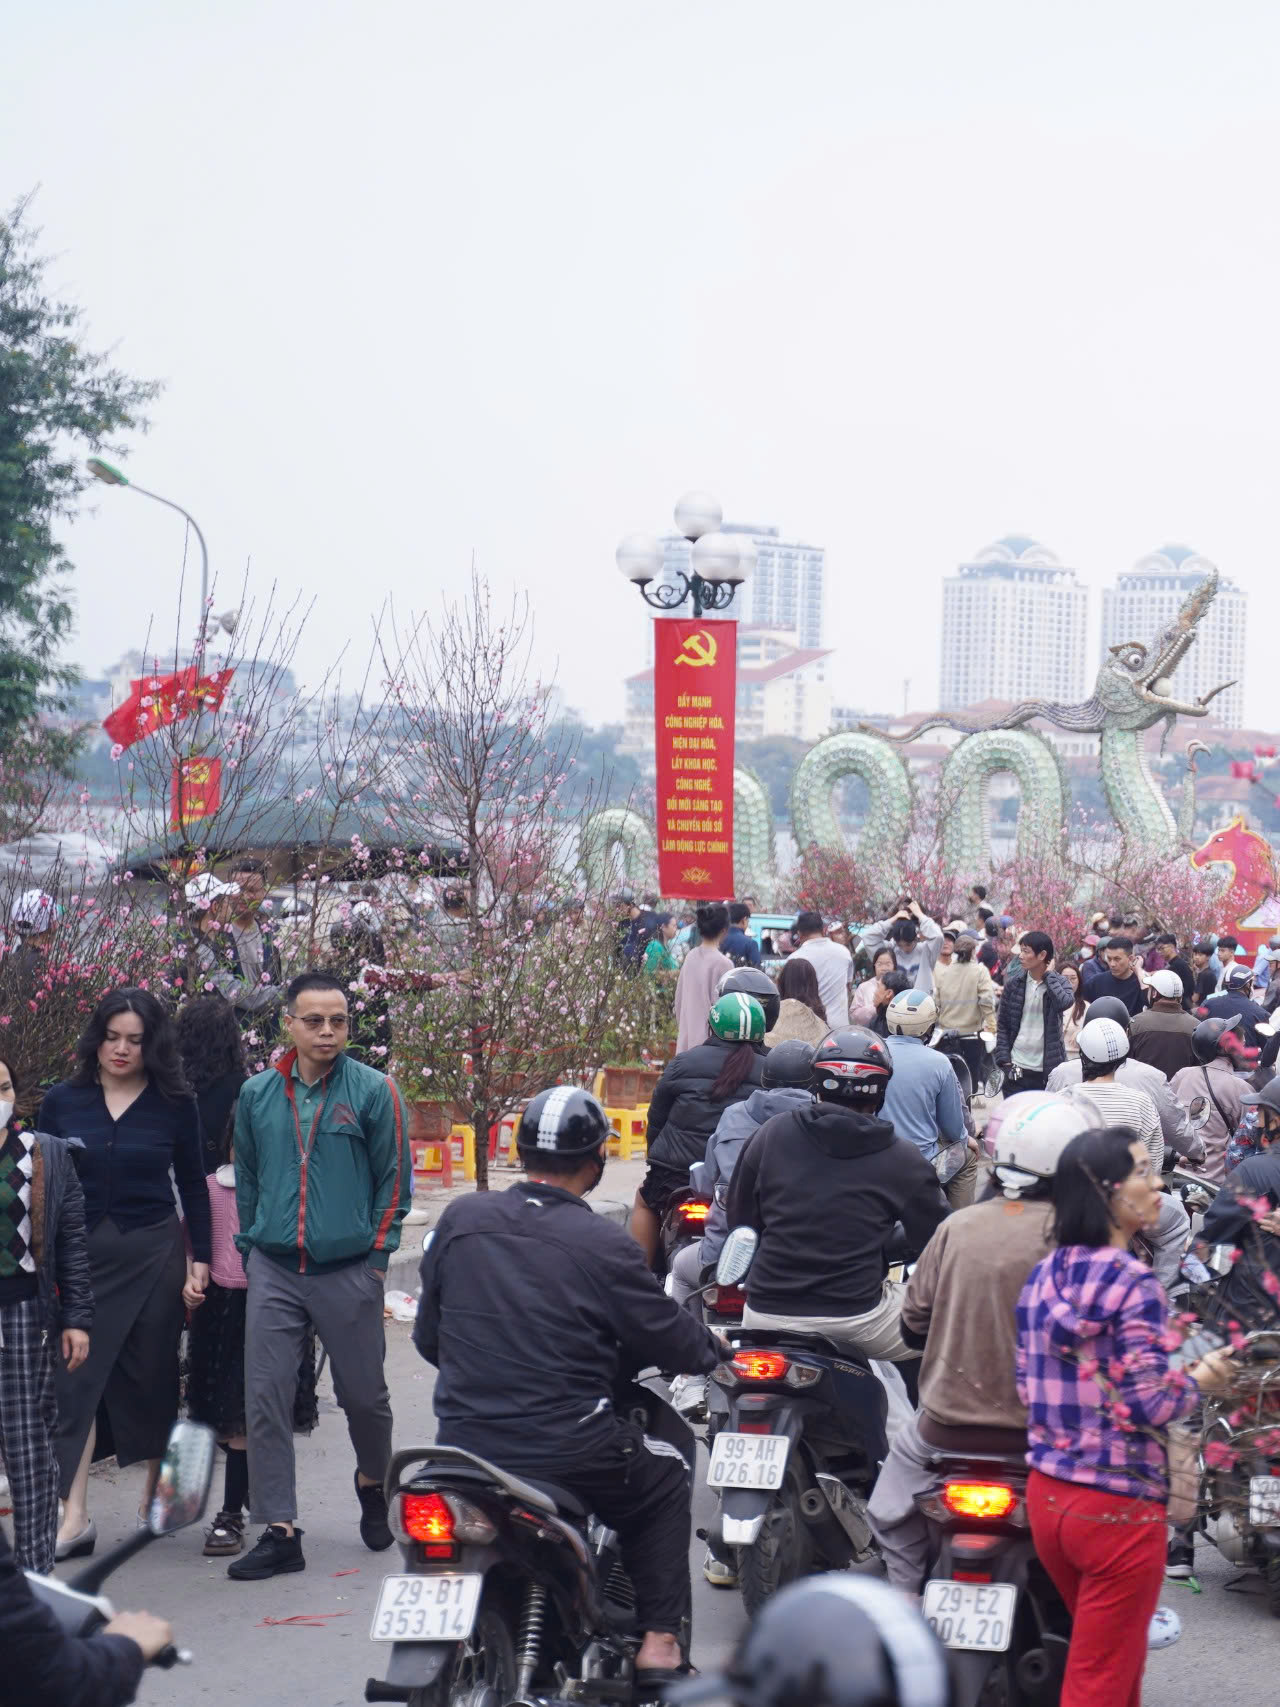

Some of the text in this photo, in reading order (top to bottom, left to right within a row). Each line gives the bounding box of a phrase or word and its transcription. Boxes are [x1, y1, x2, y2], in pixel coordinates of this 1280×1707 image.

[724, 1438, 777, 1461] 99-AH
[714, 1461, 778, 1485] 026.16
[393, 1579, 464, 1606] 29-B1
[936, 1586, 1000, 1615] 29-E2
[379, 1609, 464, 1636] 353.14
